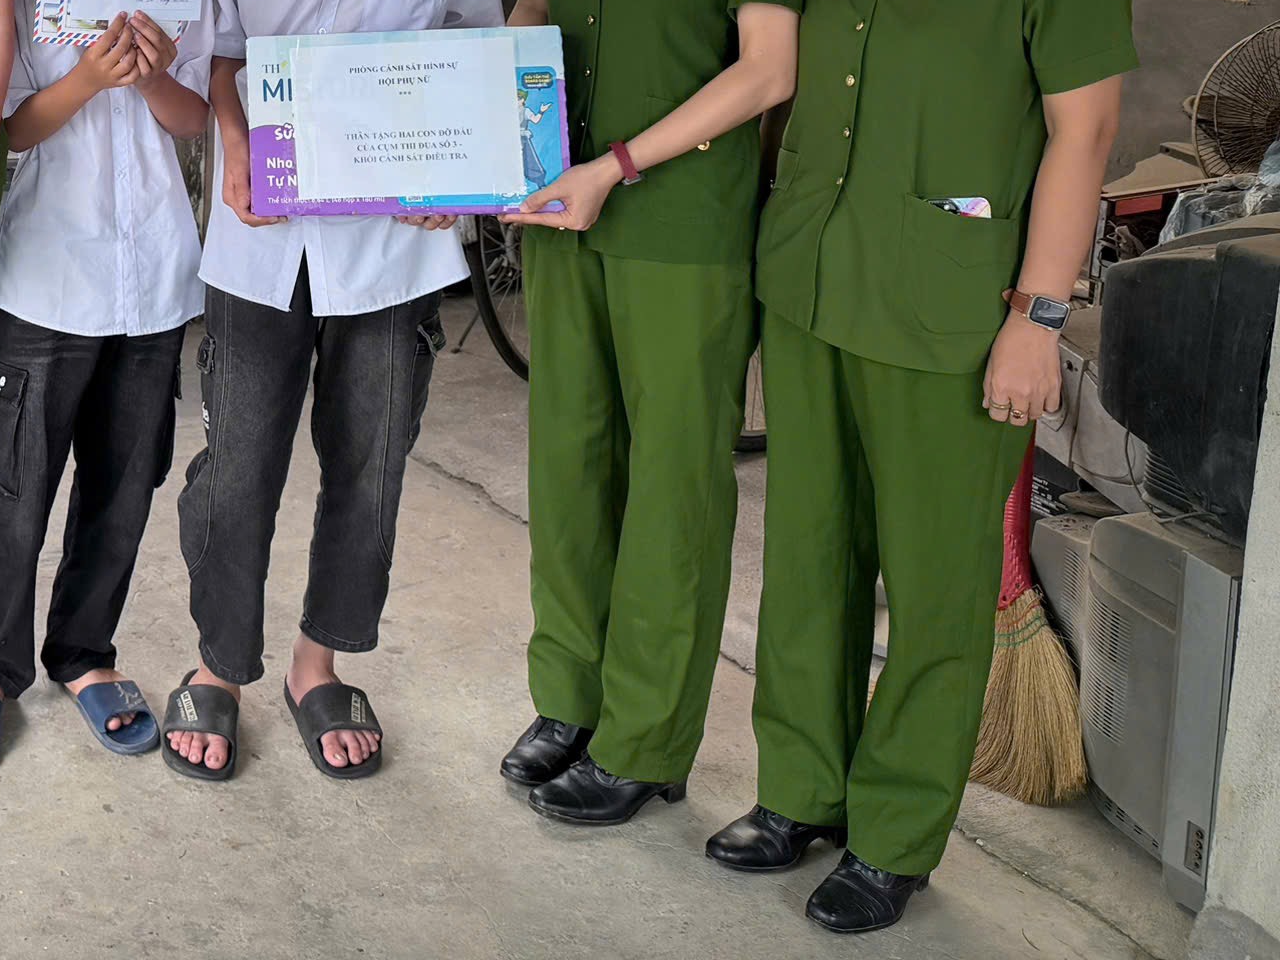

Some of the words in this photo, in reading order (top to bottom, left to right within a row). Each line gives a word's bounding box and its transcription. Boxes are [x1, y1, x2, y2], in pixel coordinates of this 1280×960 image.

[262, 64, 280, 74] TH
[349, 65, 379, 74] PHÒNG
[380, 64, 404, 73] CẢNH
[406, 62, 422, 71] SÁT
[378, 77, 395, 86] HỘI
[397, 77, 416, 86] PHỤ
[262, 78, 293, 102] MI
[267, 158, 292, 169] Nho
[267, 175, 285, 189] Tự
